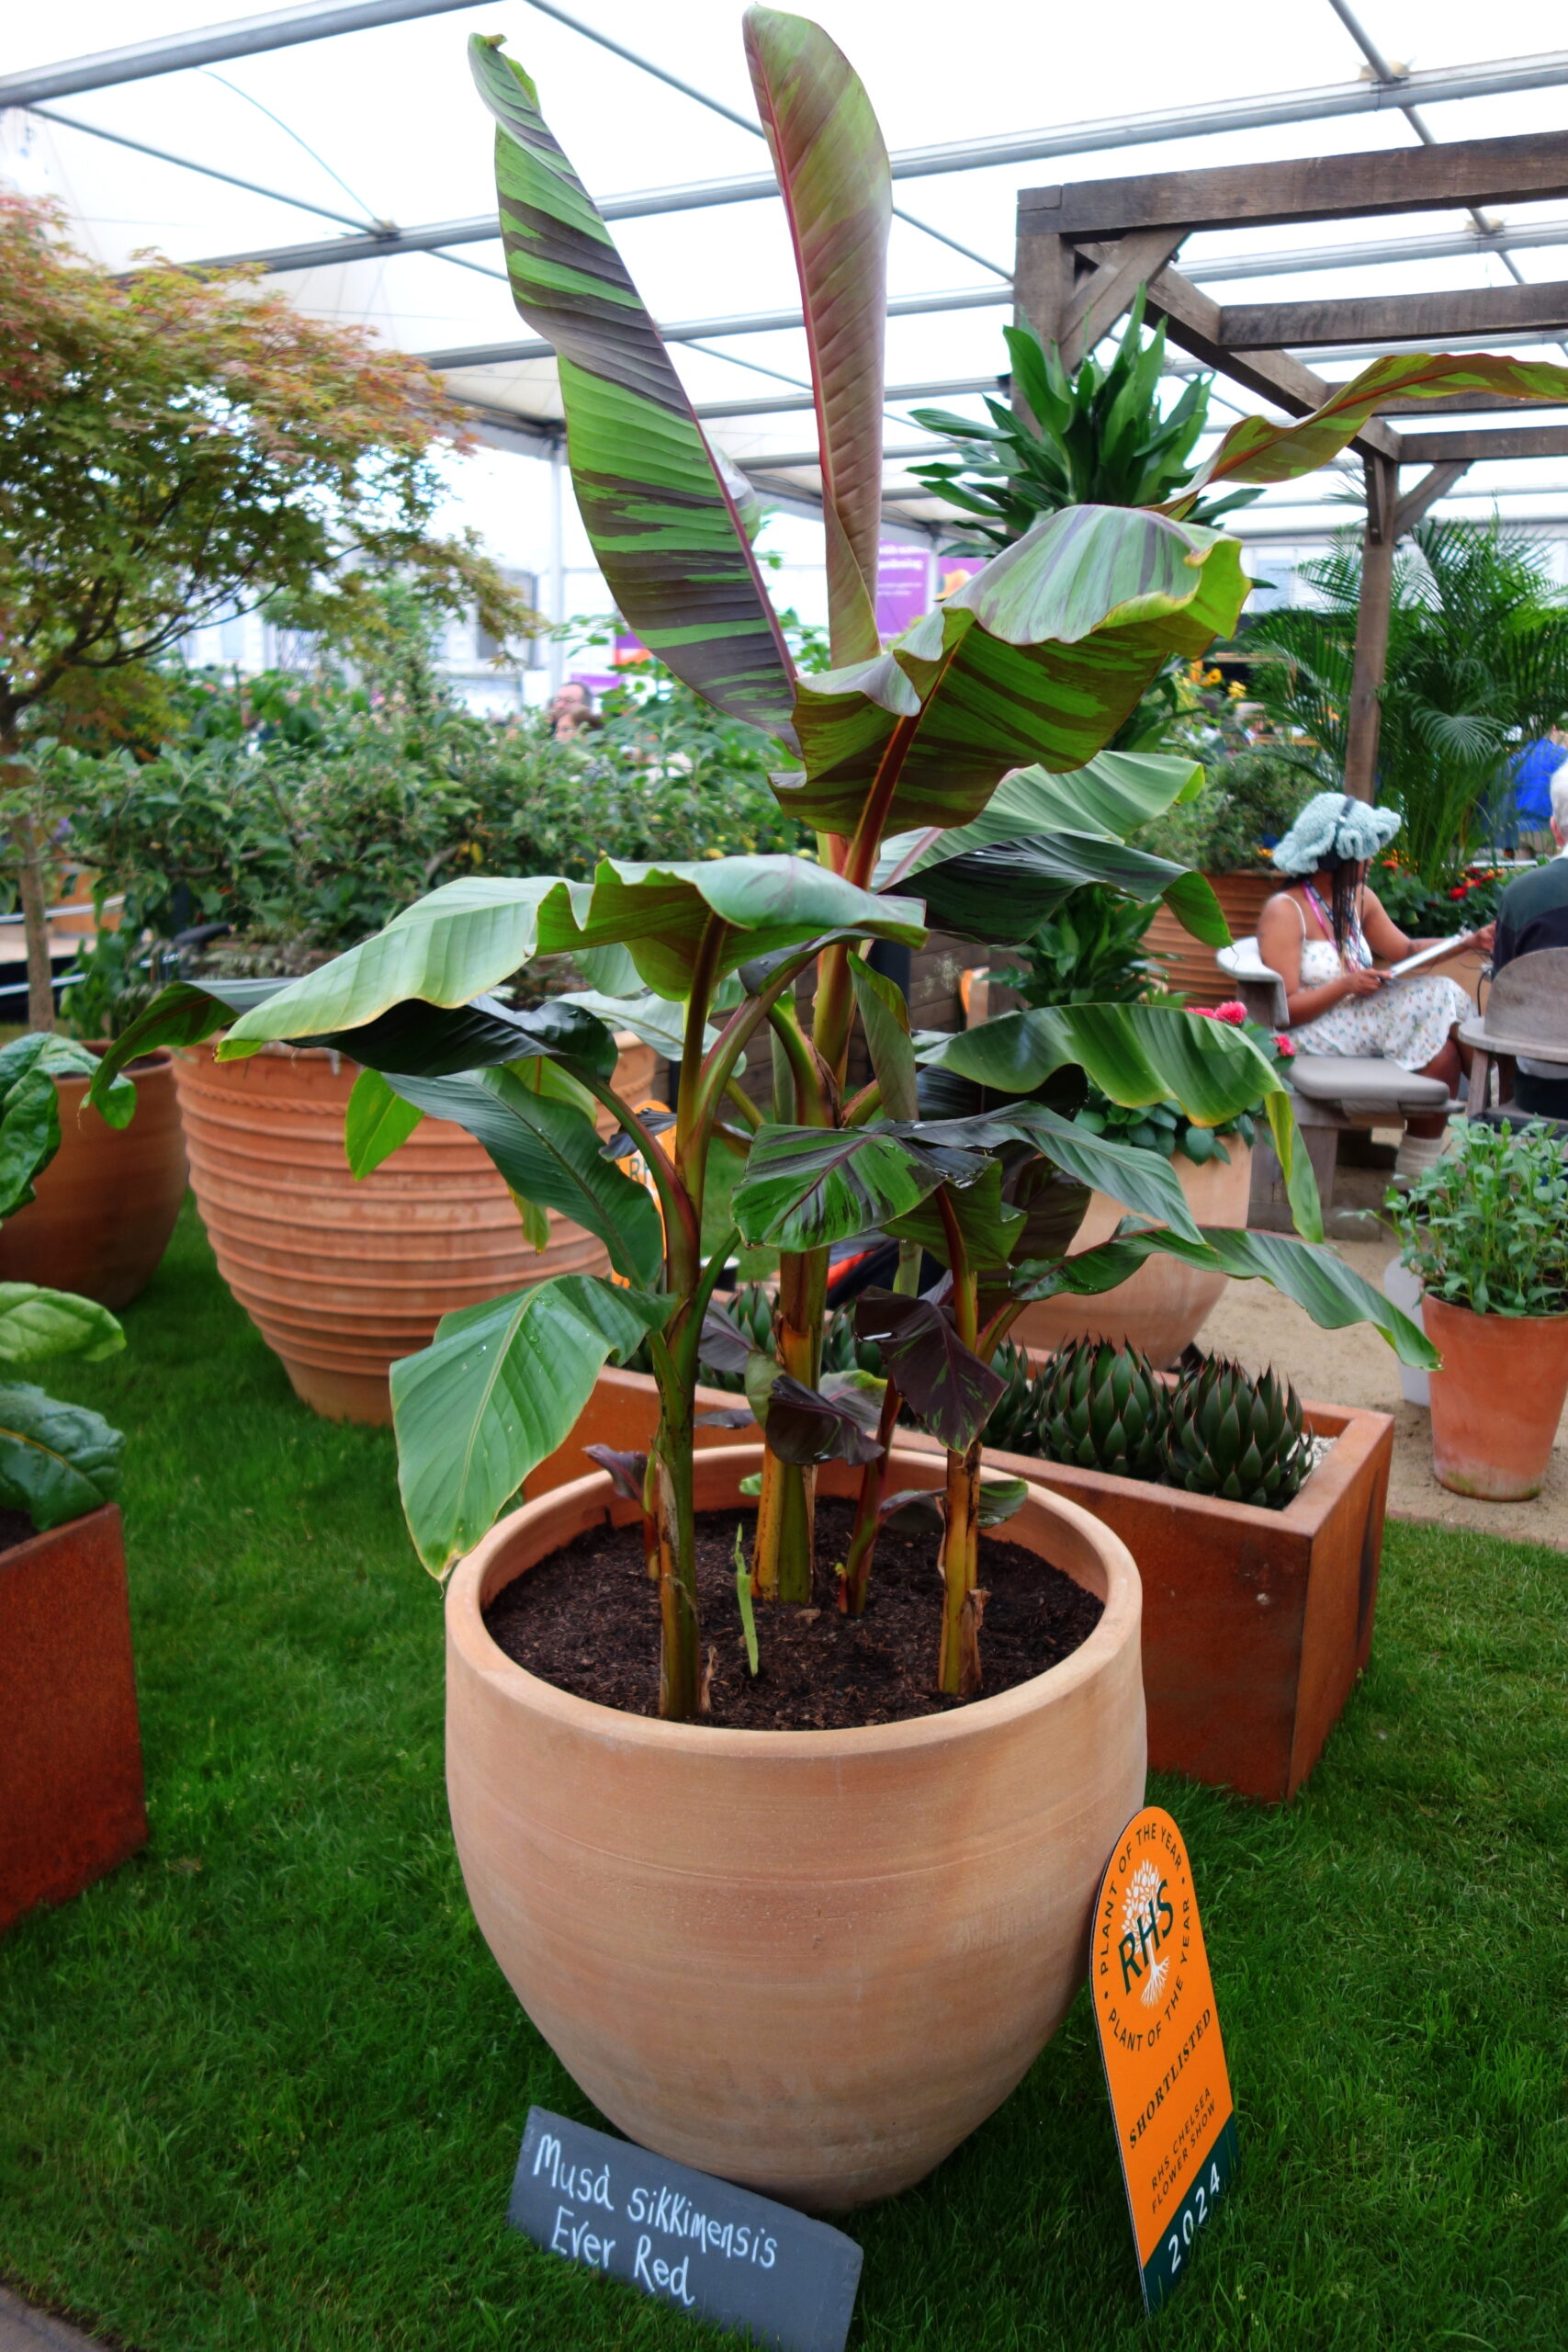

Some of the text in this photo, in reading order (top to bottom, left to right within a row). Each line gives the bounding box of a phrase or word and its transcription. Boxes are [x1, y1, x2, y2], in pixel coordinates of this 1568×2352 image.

[1100, 1823, 1182, 1976] PLANT OF THE YEAR
[1118, 1879, 1174, 1995] RHS
[1108, 1897, 1190, 2052] PLANT OF THE YEAR
[1129, 2008, 1211, 2150] SHORTLISTED
[533, 2134, 615, 2211] Musa
[1151, 2086, 1211, 2191] RHS CHELSEA
[1152, 2099, 1215, 2214] FLOWER SHOW
[551, 2206, 695, 2306] Ever Red
[1168, 2162, 1220, 2274] 2024
